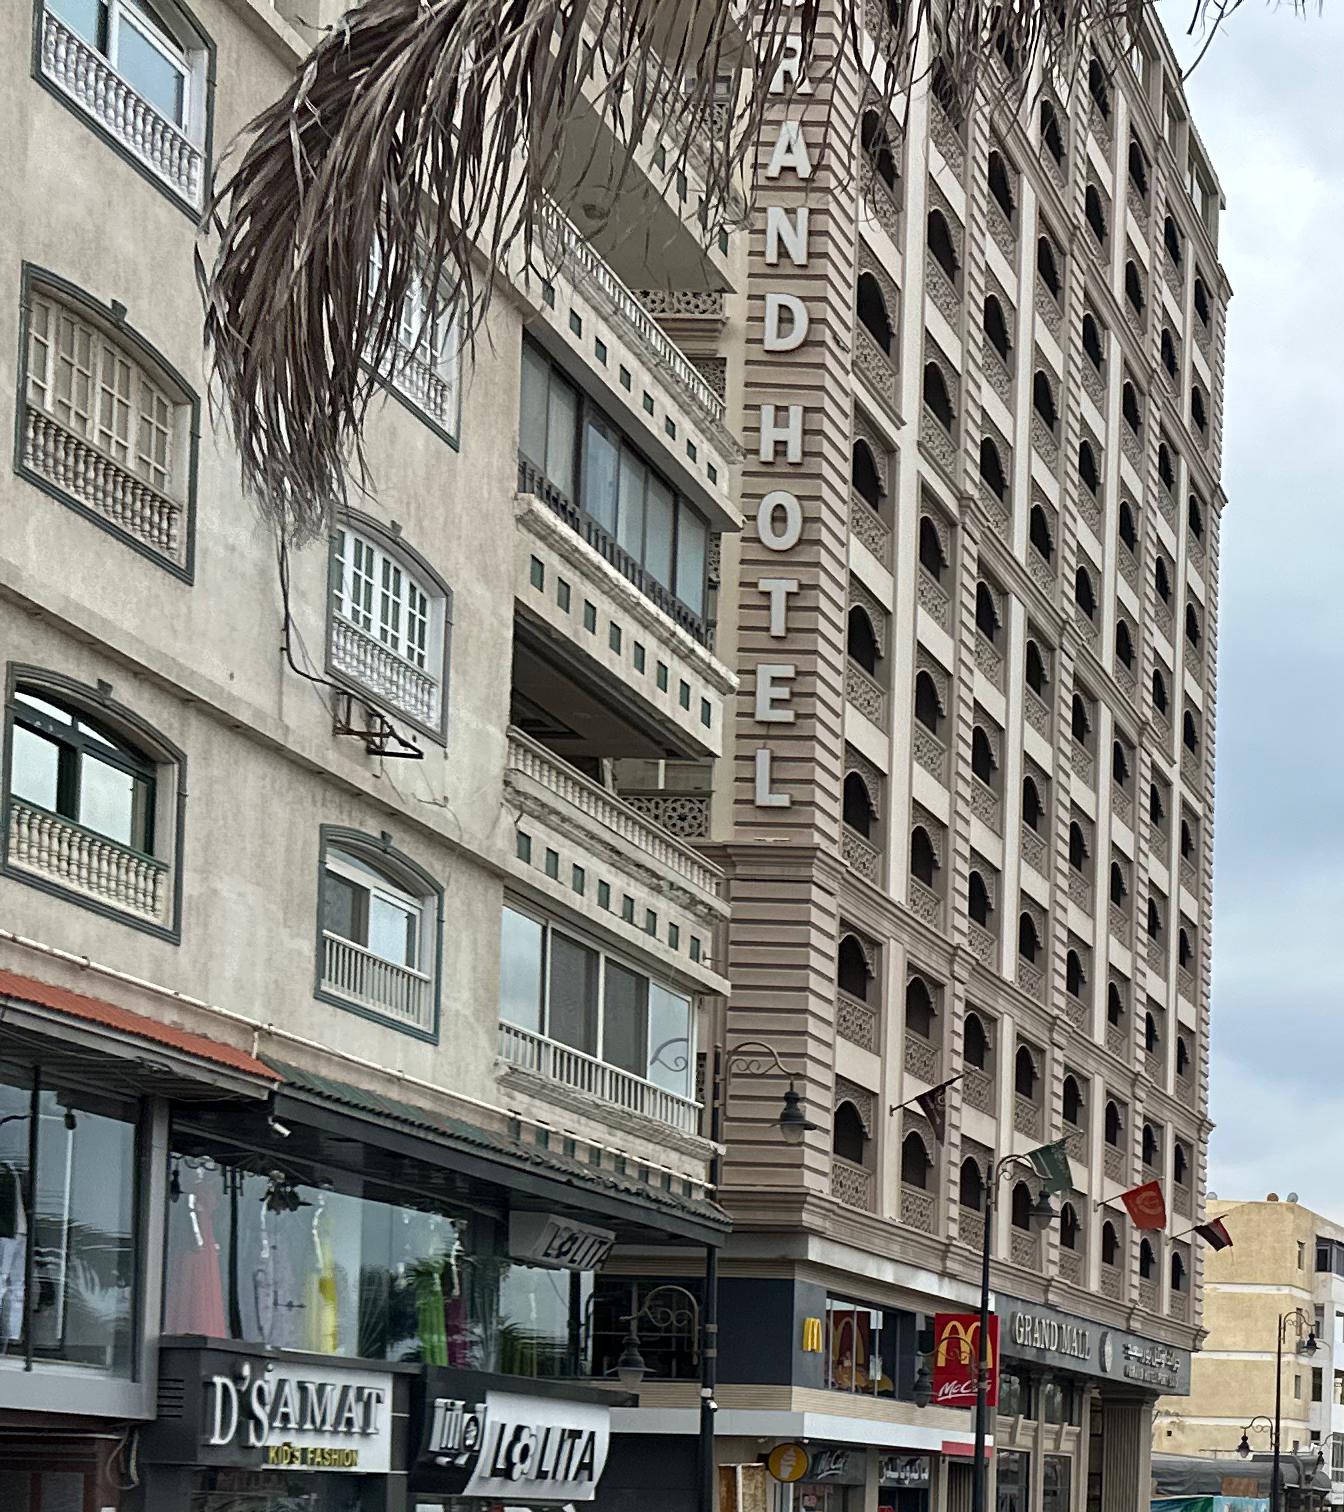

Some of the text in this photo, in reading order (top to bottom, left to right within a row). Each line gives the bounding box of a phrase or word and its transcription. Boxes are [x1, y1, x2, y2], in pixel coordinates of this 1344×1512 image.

[754, 404, 804, 808] HOTEL
[1015, 1312, 1059, 1351] GRAND
[1061, 1323, 1092, 1360] MALL
[307, 1447, 358, 1467] FASHION
